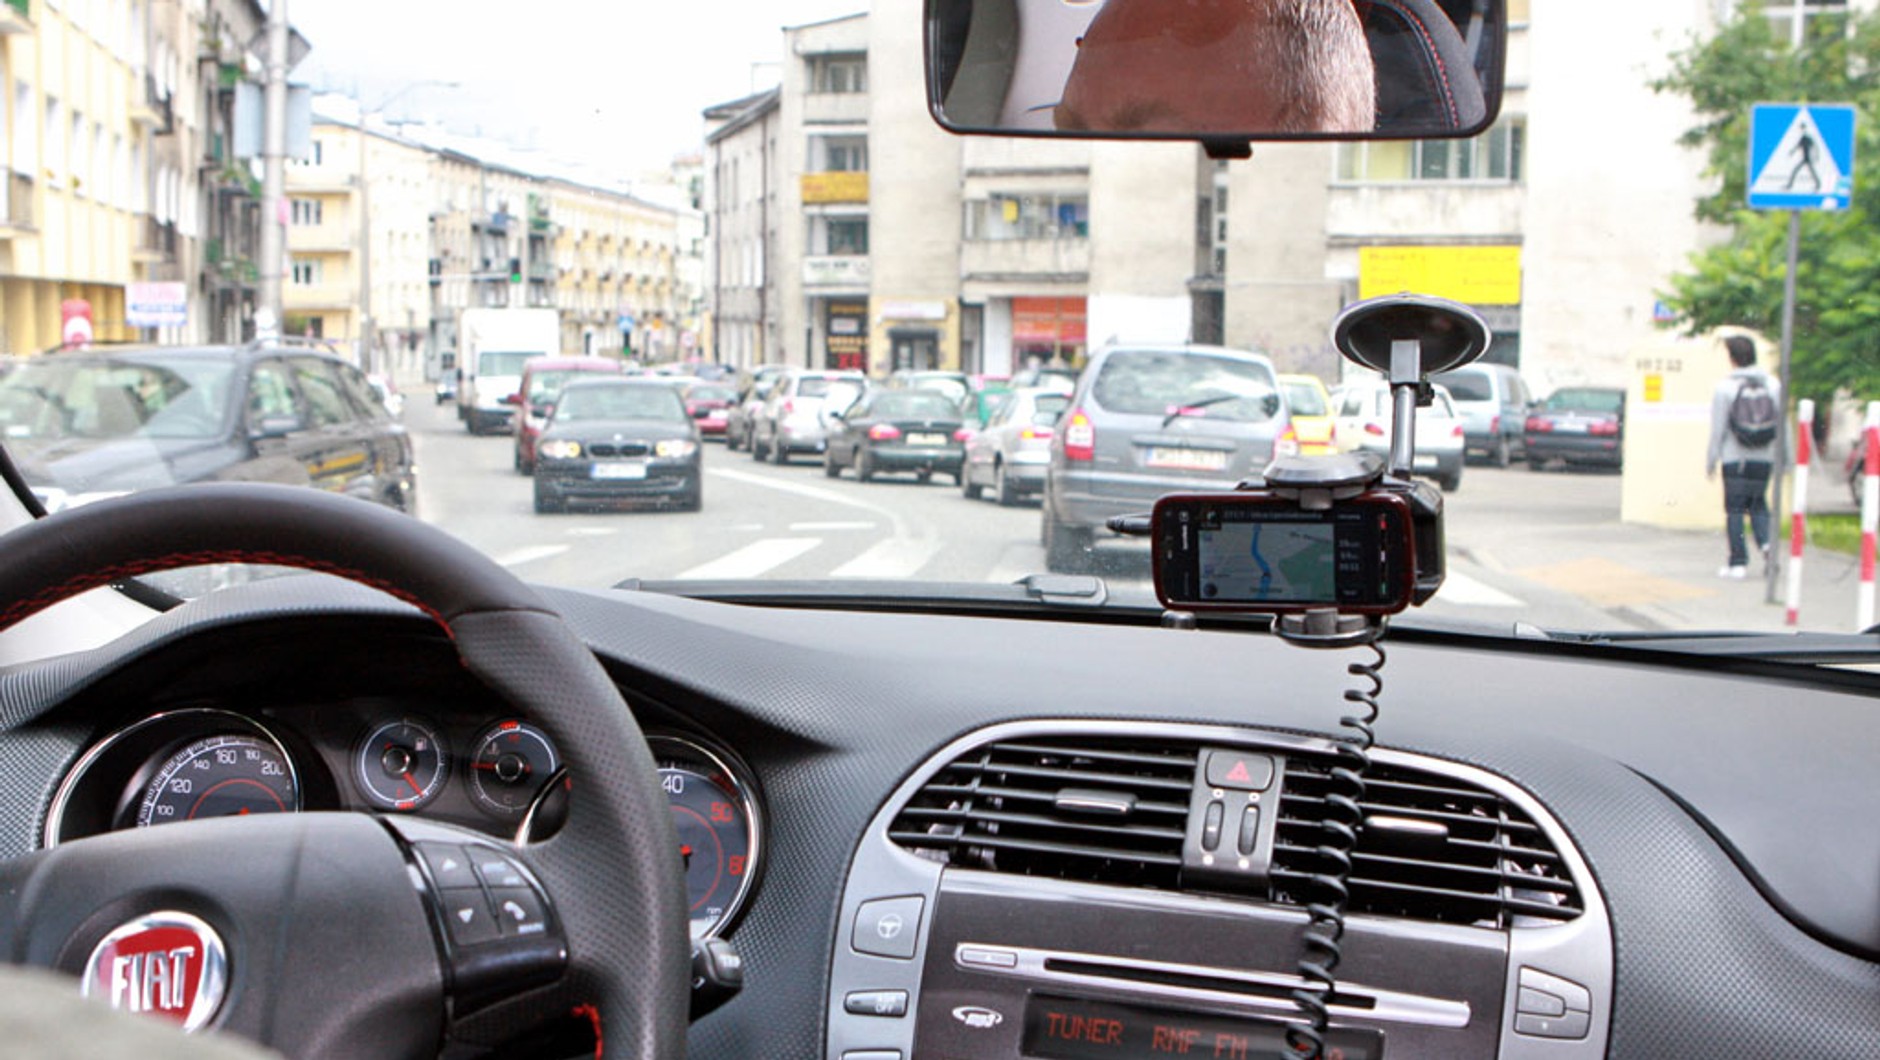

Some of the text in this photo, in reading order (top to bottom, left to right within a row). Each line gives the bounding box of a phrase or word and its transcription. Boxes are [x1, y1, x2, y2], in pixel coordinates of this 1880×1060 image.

[192, 759, 210, 770] 140
[215, 750, 237, 764] 160
[170, 779, 192, 793] 120
[662, 775, 684, 794] 40
[157, 805, 174, 816] 100
[711, 802, 733, 823] 50
[111, 946, 195, 1011] FIAT
[1047, 1013, 1249, 1059] TUNER RMF FM
